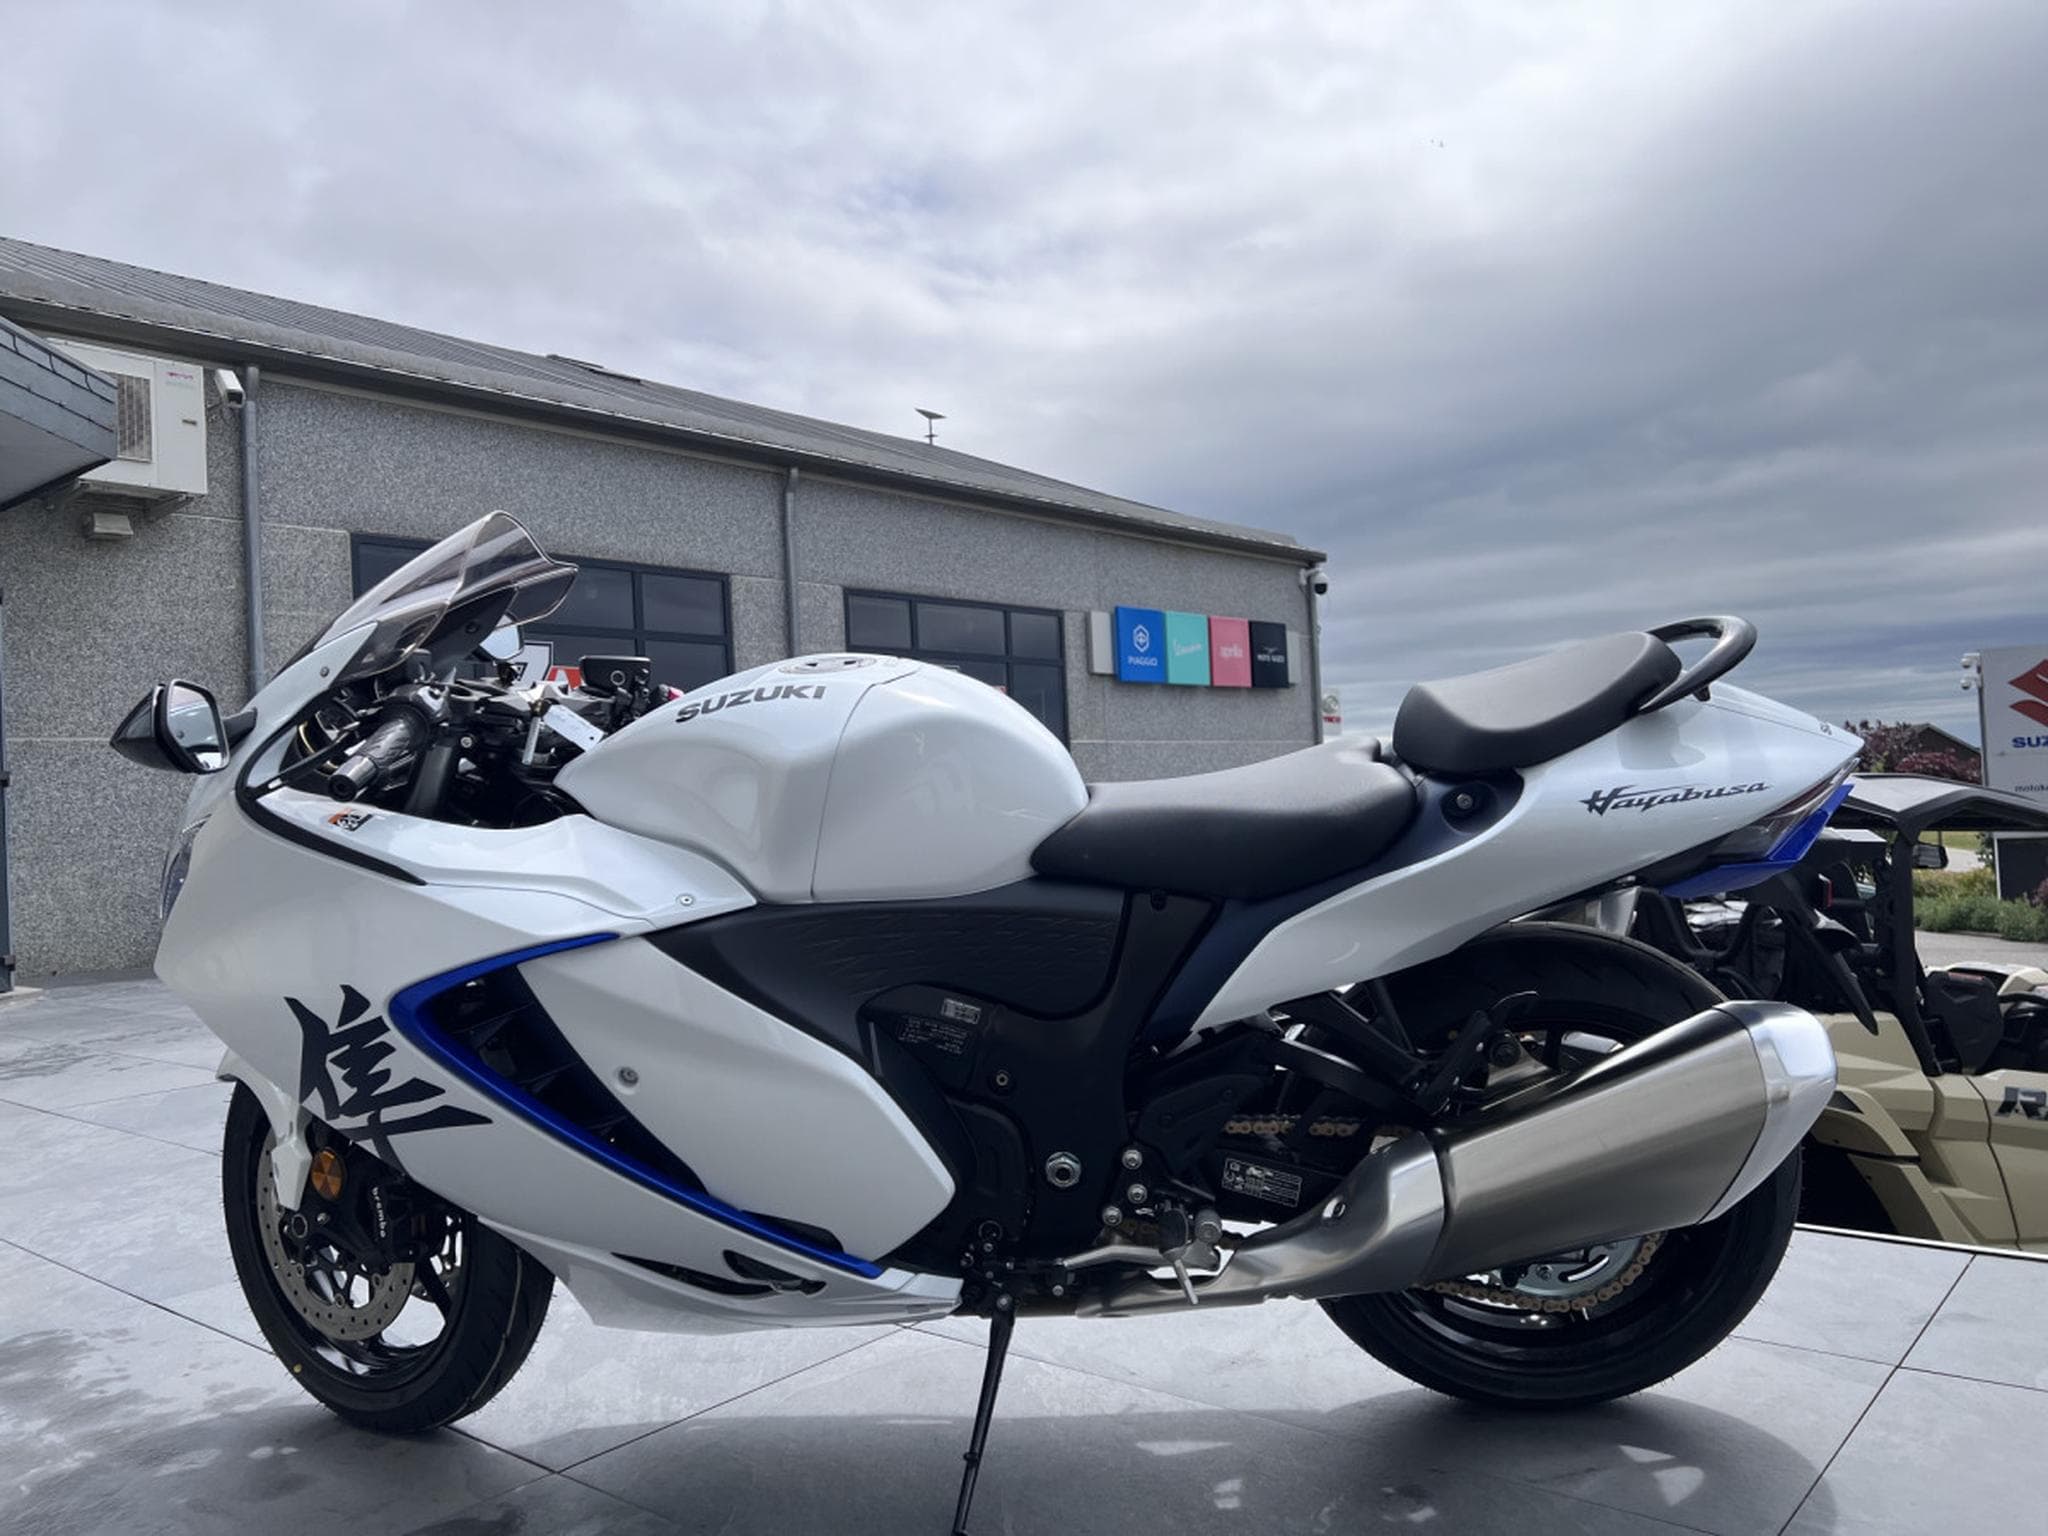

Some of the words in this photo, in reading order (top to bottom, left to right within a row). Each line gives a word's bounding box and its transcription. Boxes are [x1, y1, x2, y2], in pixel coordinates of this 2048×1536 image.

[1127, 655, 1158, 667] PIAGGIO
[675, 684, 827, 724] SUZUKI
[1579, 780, 1772, 816] Hayabusa
[284, 984, 494, 1180] 隼
[371, 1186, 387, 1239] brembo
